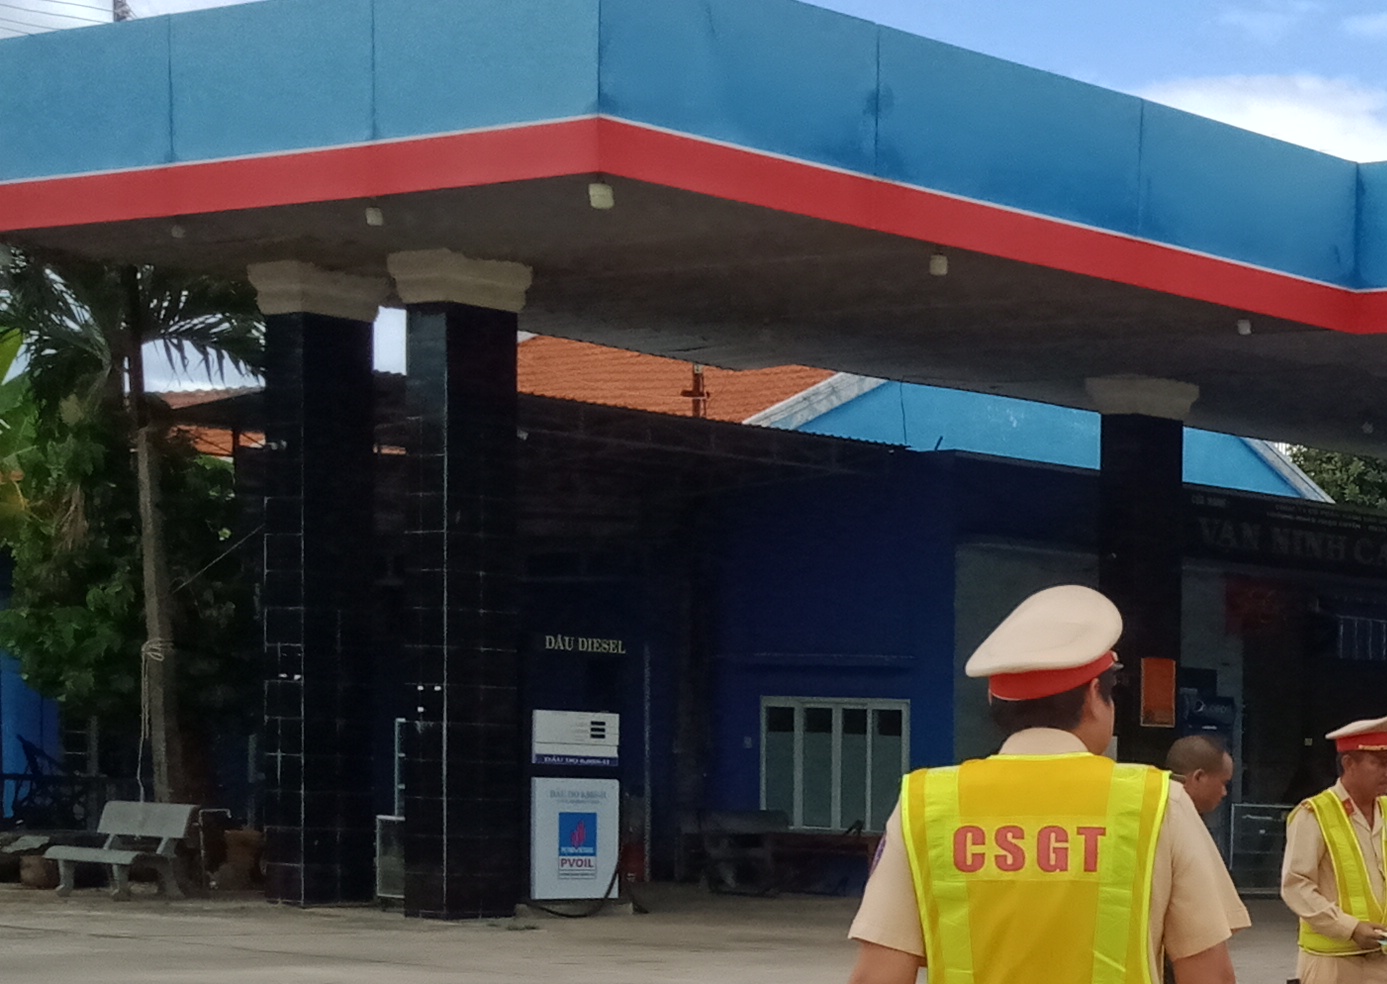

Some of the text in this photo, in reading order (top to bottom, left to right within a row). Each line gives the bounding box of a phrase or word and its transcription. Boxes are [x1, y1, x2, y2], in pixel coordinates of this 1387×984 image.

[578, 637, 627, 654] DIESEL
[953, 825, 1107, 873] CSGT
[560, 857, 595, 868] PVOIL
